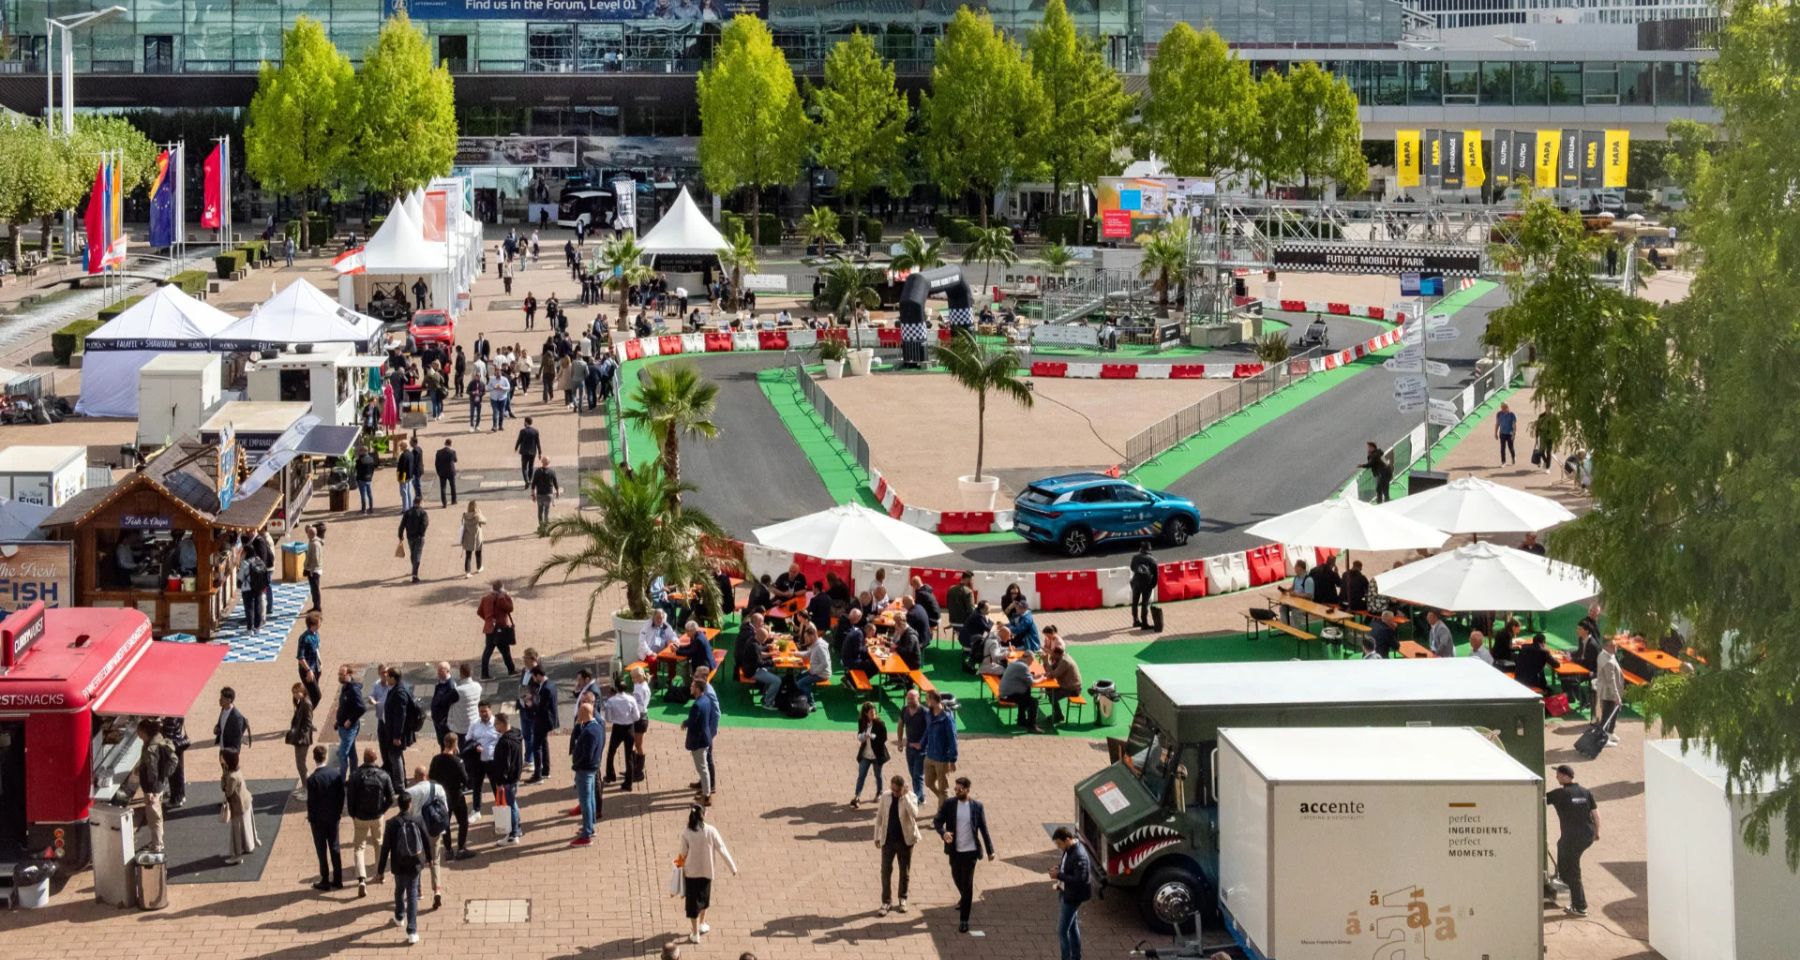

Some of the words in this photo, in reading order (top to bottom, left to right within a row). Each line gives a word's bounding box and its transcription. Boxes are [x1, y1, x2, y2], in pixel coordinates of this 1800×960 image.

[466, 0, 490, 9] Find
[493, 1, 507, 9] us
[511, 0, 521, 9] in
[524, 0, 543, 9] the
[546, 0, 586, 11] Forum,
[589, 0, 621, 9] Level
[623, 0, 637, 9] 01
[1431, 140, 1440, 165] MAPA
[1468, 142, 1476, 167] MAPA
[1543, 141, 1551, 167] MAPA
[1587, 142, 1597, 168] MAPA
[1326, 254, 1358, 265] FUTURE
[1360, 256, 1399, 267] MOBILITY
[1402, 257, 1425, 267] PARK
[116, 340, 138, 348] FALAFEL
[125, 516, 141, 525] Fish
[20, 561, 57, 577] Fresh
[1300, 801, 1365, 814] accente
[1448, 814, 1481, 825] perfect
[1448, 827, 1511, 835] INGREDIENTS,
[1448, 837, 1481, 848] perfect
[1448, 849, 1497, 857] MOMENTS.
